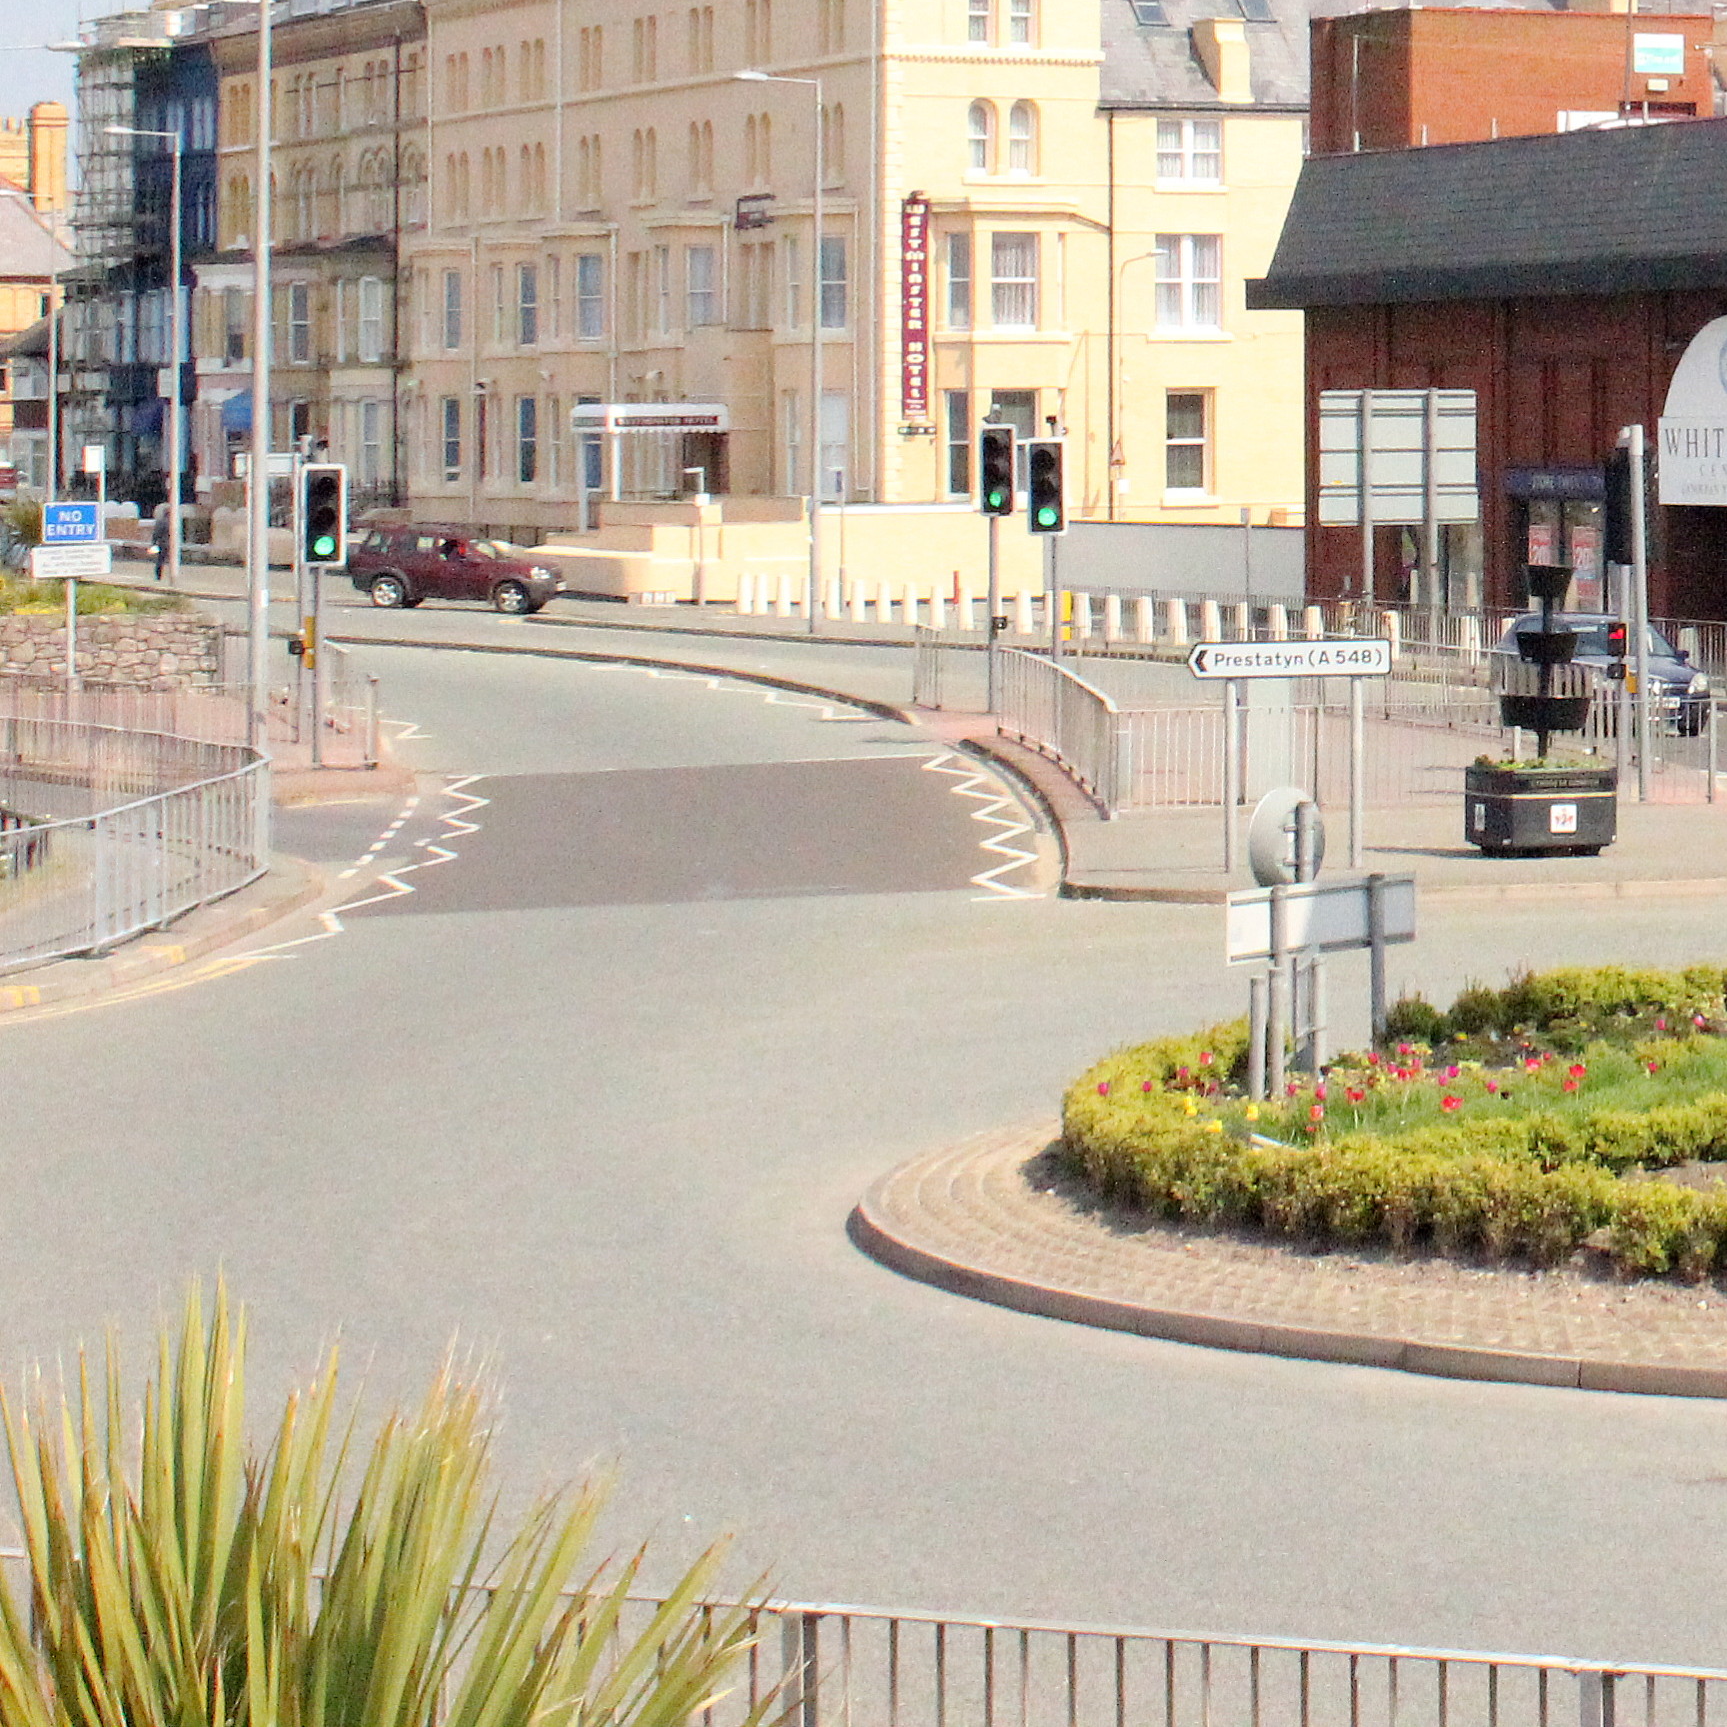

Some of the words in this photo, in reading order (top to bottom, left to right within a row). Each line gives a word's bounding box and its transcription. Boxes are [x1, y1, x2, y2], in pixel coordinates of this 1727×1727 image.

[906, 341, 925, 397] HOTEL
[59, 510, 82, 522] NO
[47, 524, 95, 536] ENTRY
[1214, 653, 1304, 669] Prestatyn
